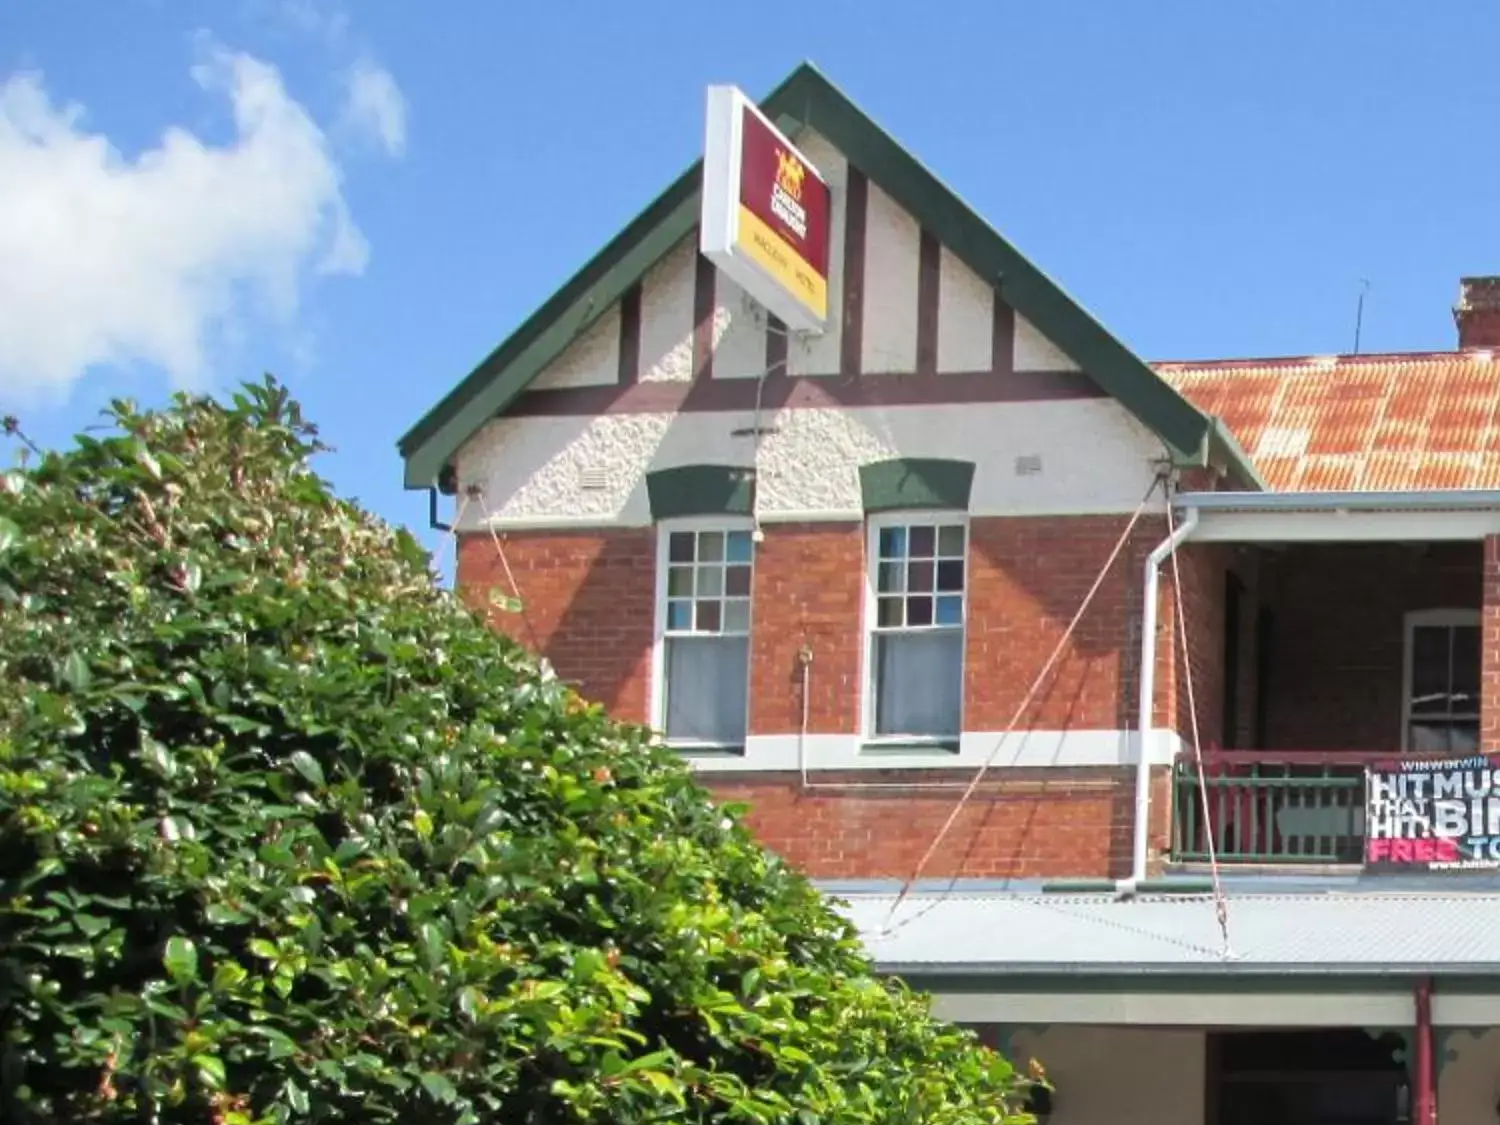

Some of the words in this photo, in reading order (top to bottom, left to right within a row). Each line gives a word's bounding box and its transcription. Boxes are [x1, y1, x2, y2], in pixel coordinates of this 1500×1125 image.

[1371, 773, 1431, 800] HIT
[1371, 798, 1429, 817] THAT
[1368, 838, 1461, 863] FREE
